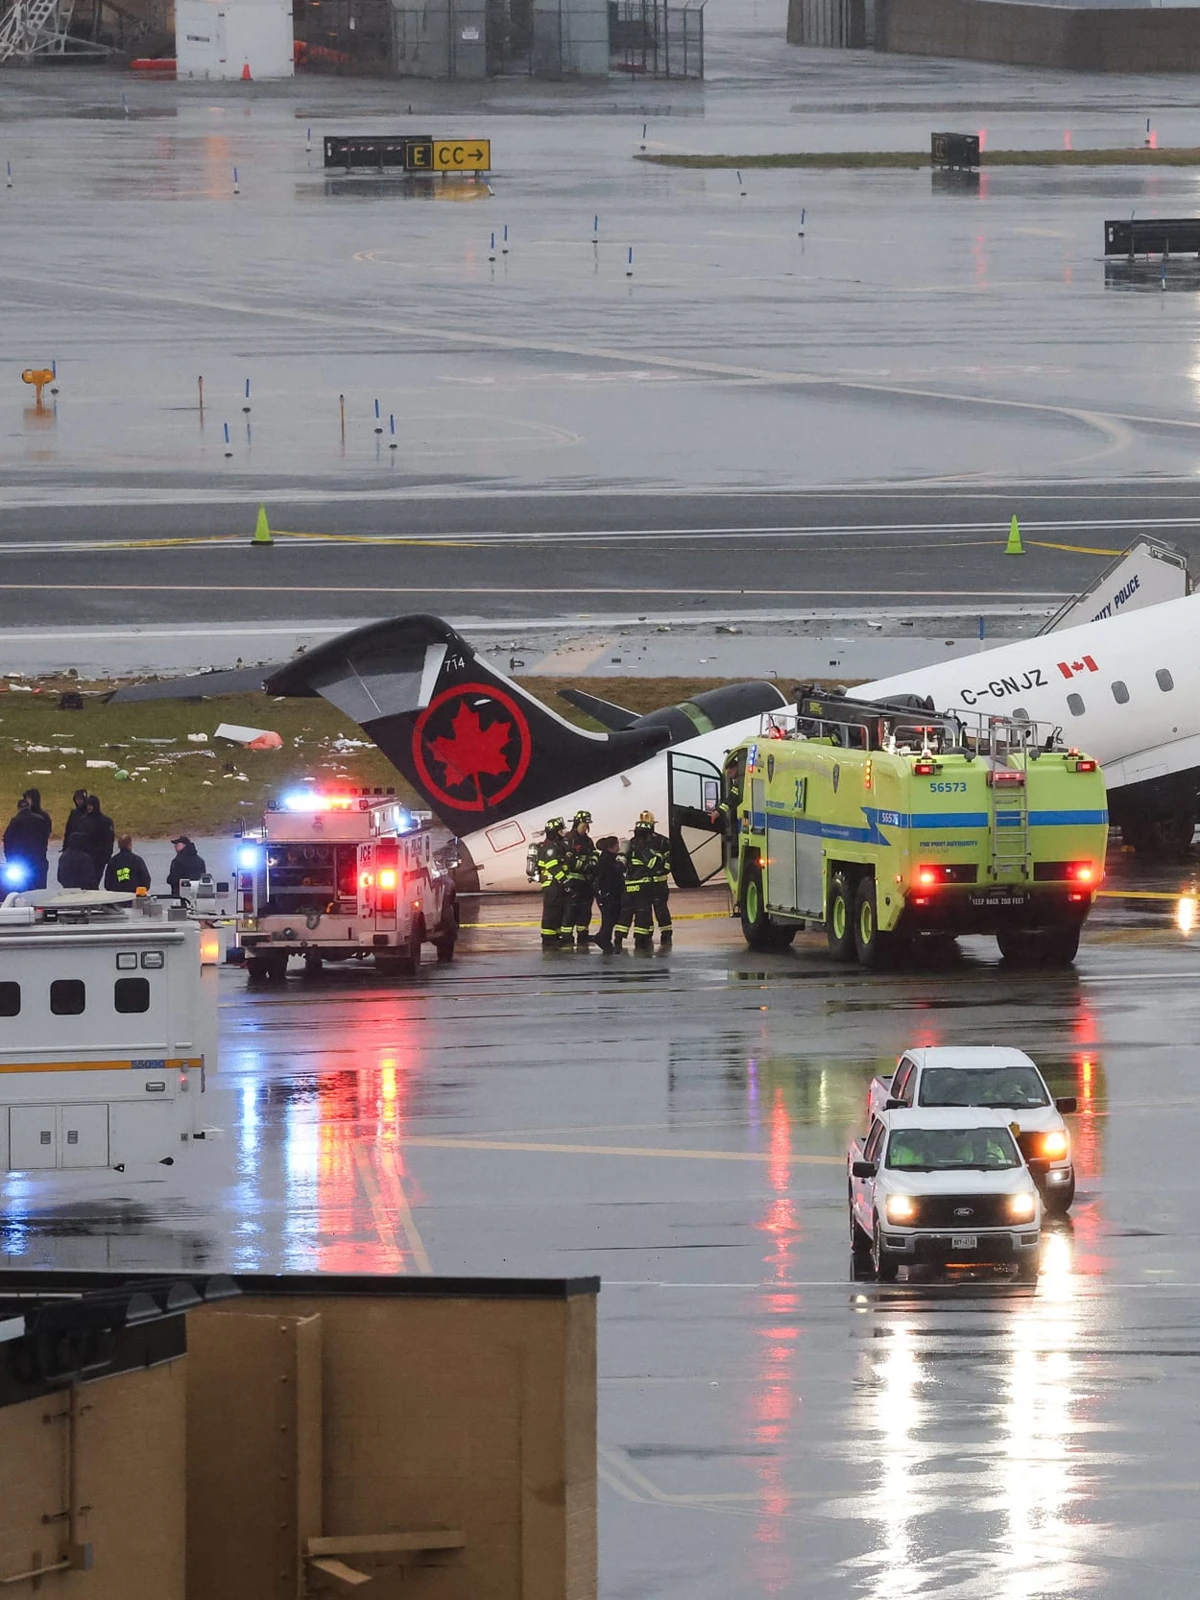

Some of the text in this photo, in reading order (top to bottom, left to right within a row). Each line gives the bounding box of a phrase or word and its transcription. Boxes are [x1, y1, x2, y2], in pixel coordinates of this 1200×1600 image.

[414, 147, 424, 165] E
[439, 147, 464, 164] CC
[1114, 574, 1140, 609] POLICE
[444, 656, 465, 672] 714
[960, 669, 1048, 705] C-GNJZ
[930, 783, 967, 793] 56573
